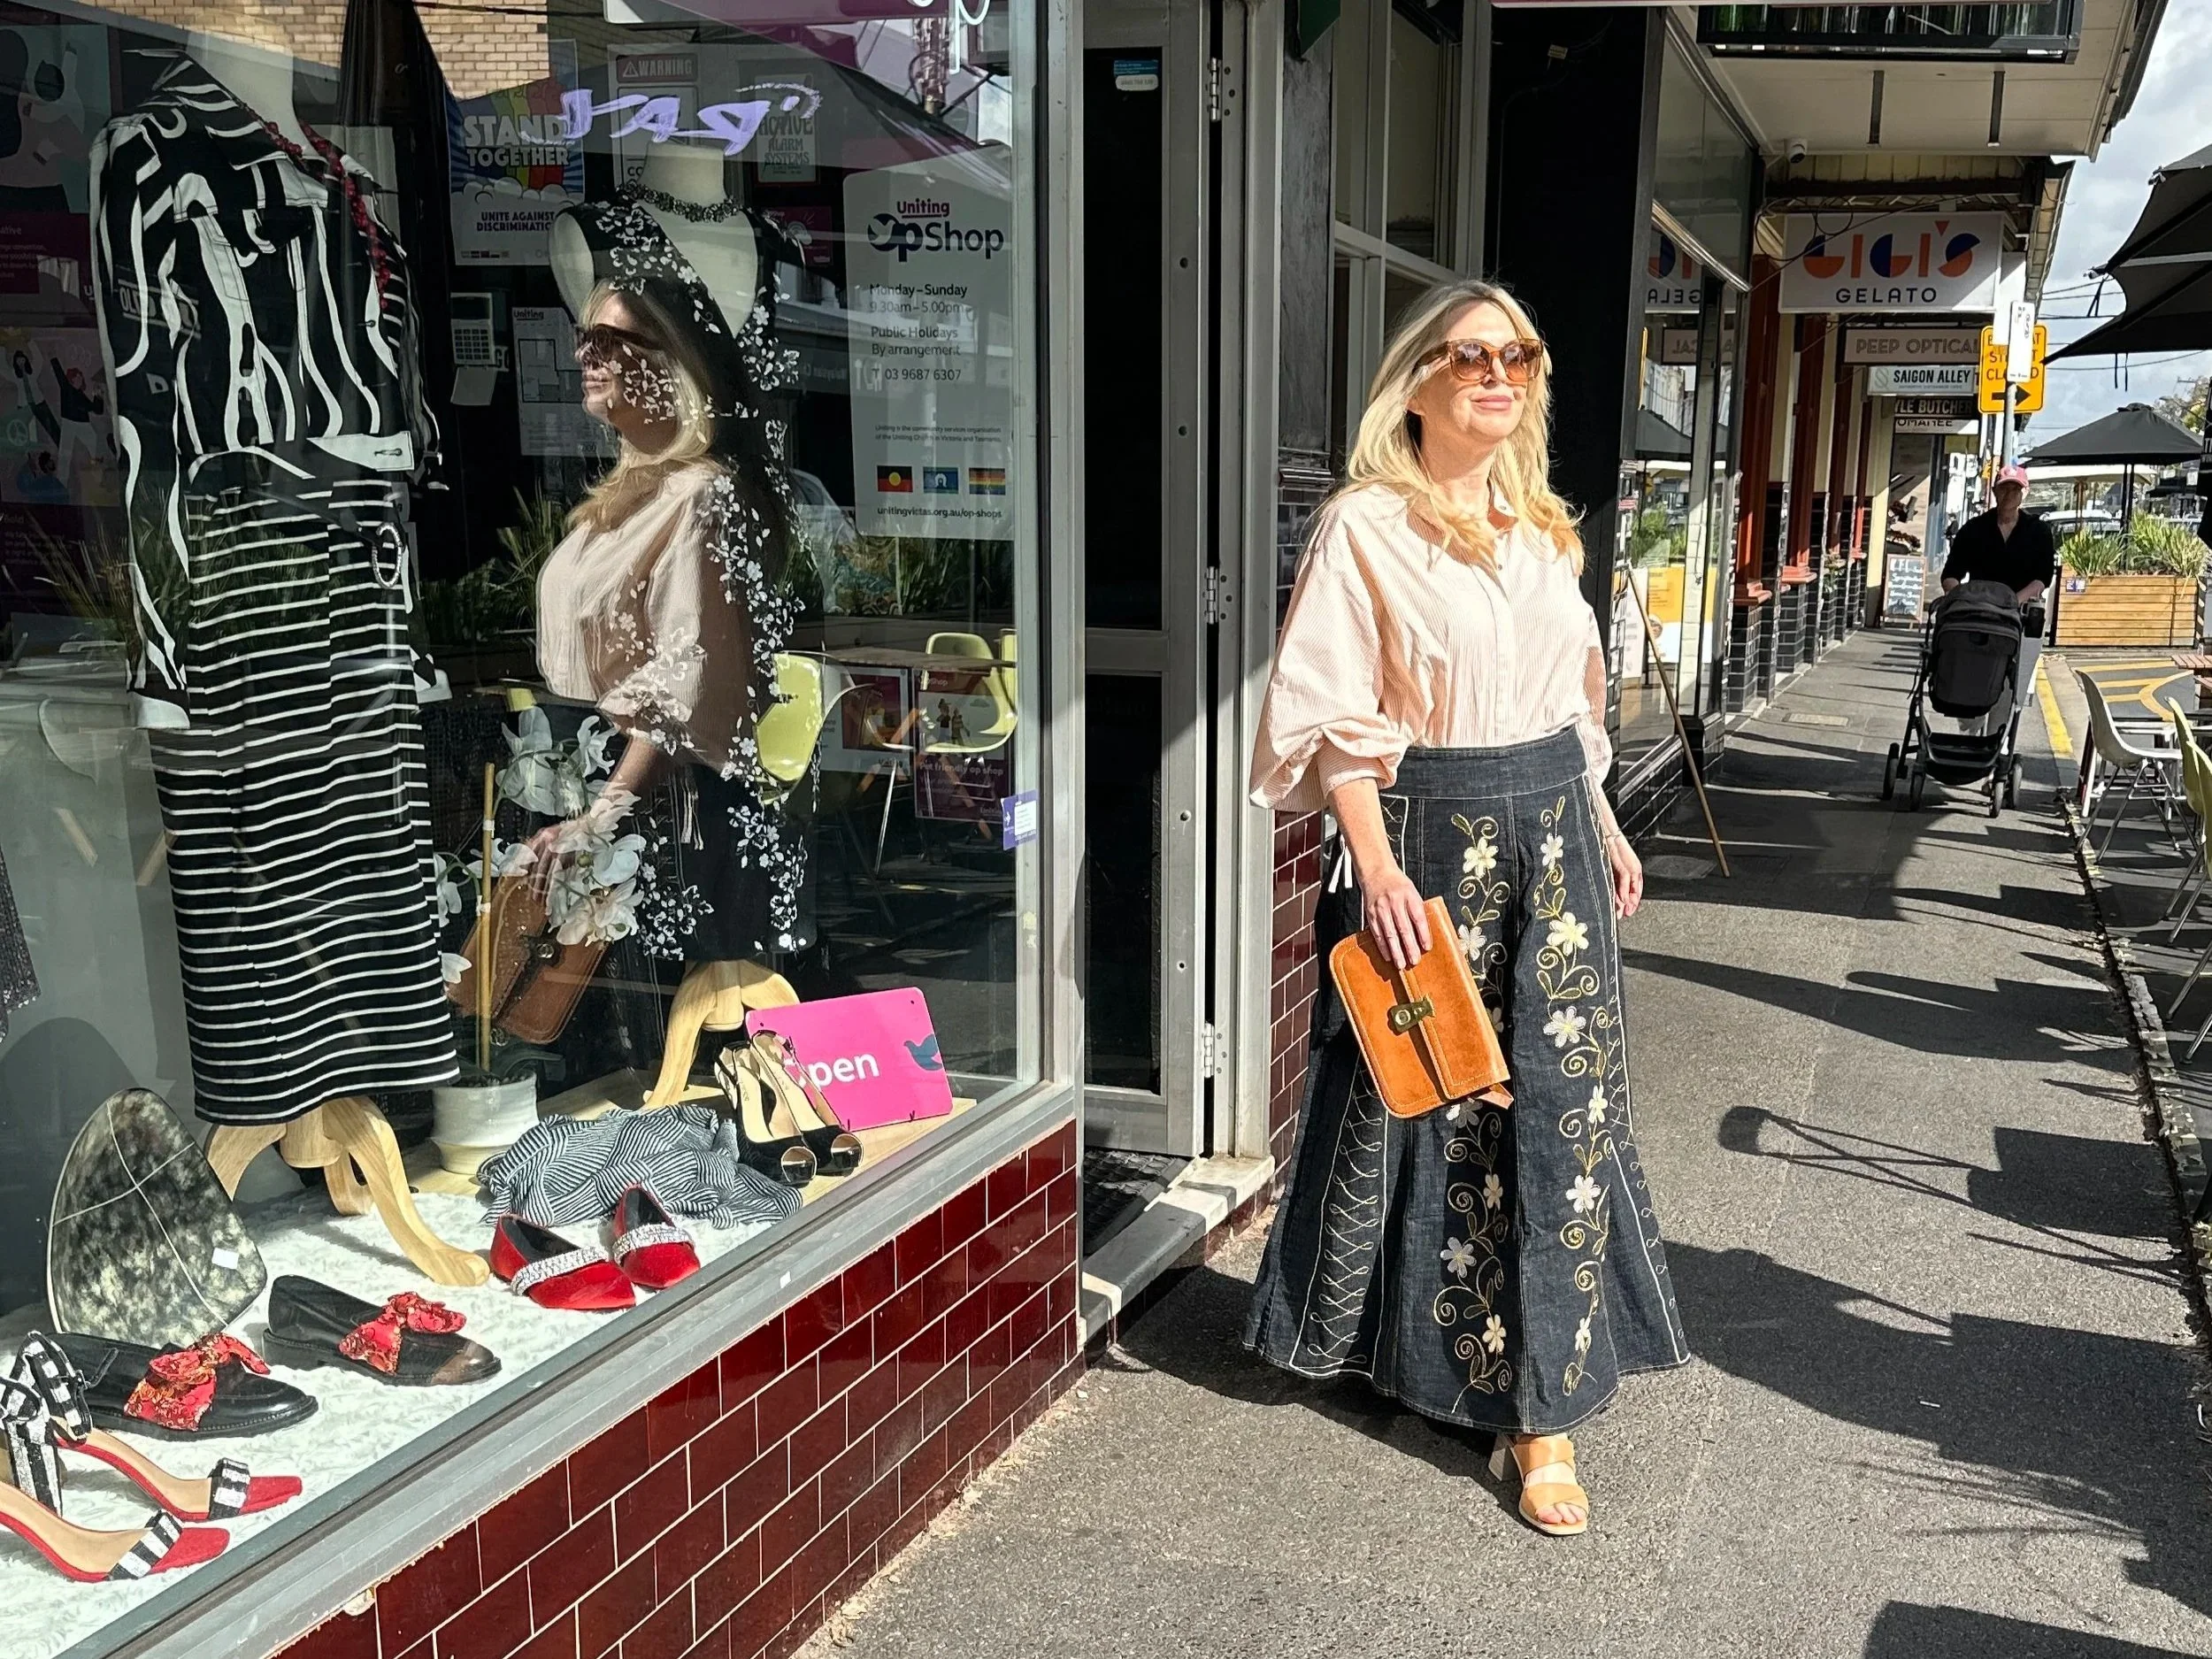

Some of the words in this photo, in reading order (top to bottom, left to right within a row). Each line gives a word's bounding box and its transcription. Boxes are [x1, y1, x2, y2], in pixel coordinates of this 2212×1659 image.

[638, 58, 692, 77] WARNING
[464, 114, 567, 147] STAND
[768, 138, 803, 151] ALARM
[466, 147, 570, 166] TOGETHER
[764, 152, 810, 166] SYSTEMS
[896, 198, 950, 217] Uniting
[481, 211, 510, 221] UNITE
[511, 211, 555, 221] AGAINST
[477, 221, 551, 232] DISCRIMINATIO
[870, 283, 915, 298] Monday
[925, 284, 968, 298] Sunday
[1836, 288, 1937, 303] GELATO
[513, 309, 544, 320] Uniting
[872, 326, 906, 338] Public
[909, 326, 958, 341] Holidays
[872, 343, 886, 357] By
[887, 346, 961, 358] arrangement
[1855, 338, 1900, 354] PEEP
[885, 368, 898, 380] 03
[902, 368, 929, 380] 9687
[933, 369, 961, 380] 6307
[1893, 370, 1932, 383] SAIGON
[1937, 369, 1970, 383] ALLEY
[1918, 399, 1972, 414] BUTCHER
[878, 506, 1002, 518] unitingvictas.org.au/op-shops
[983, 764, 1003, 775] shop
